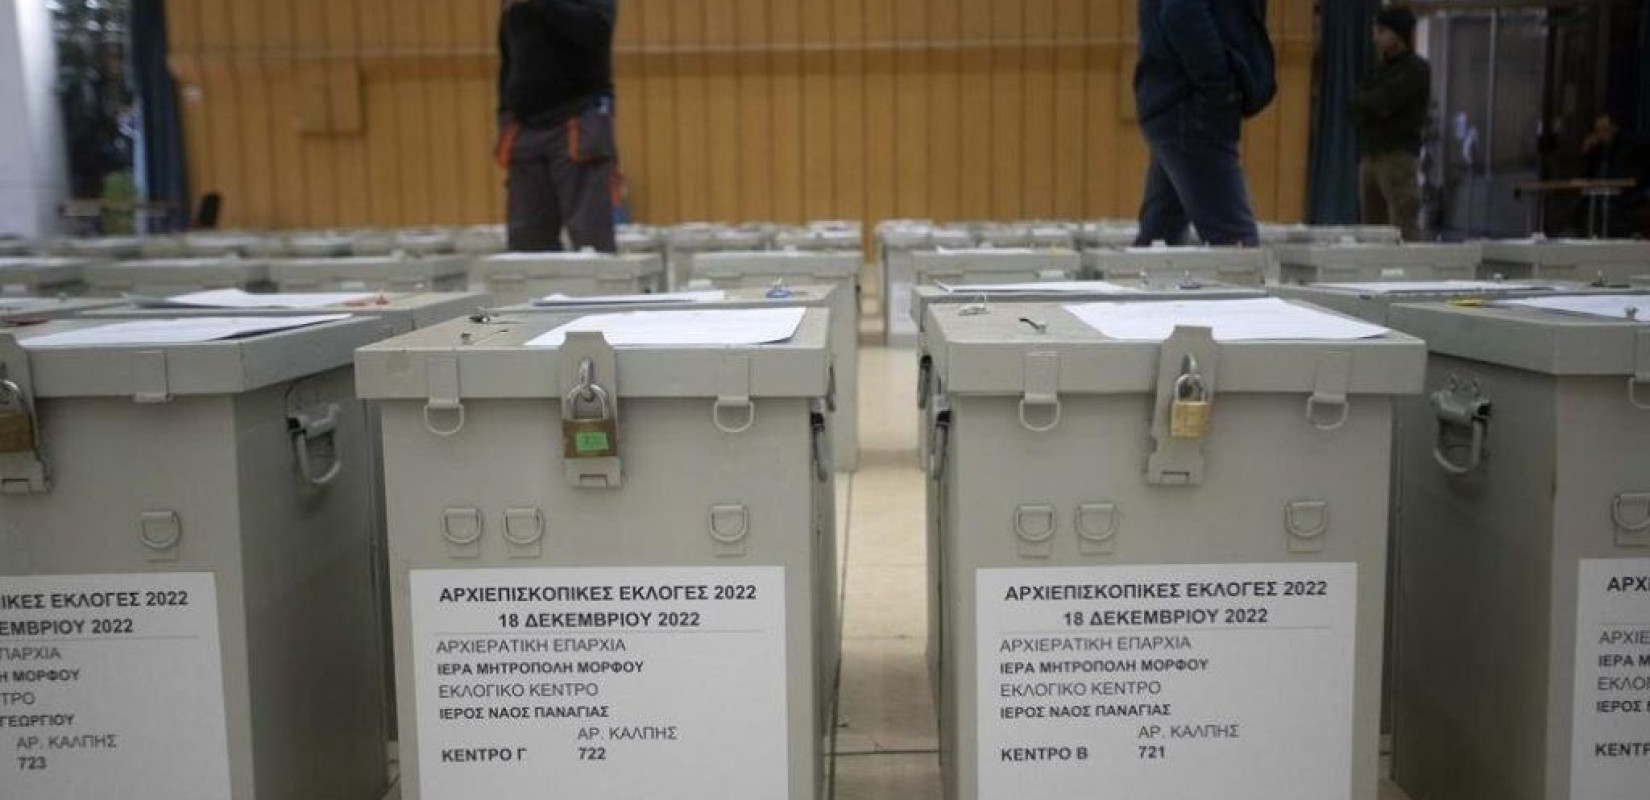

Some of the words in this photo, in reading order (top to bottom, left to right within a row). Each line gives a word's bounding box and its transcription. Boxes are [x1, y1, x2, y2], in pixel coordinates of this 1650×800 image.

[440, 586, 612, 602] ΑΡΧΙΕΠΙΣΚΟΠΙΚΕΣ
[620, 585, 708, 600] ΕΚΛΟΓΕΣ
[714, 585, 756, 600] 2022
[1006, 583, 1180, 600] ΑΡΧΙΕΠΙΣΚΟΠΙΚΕΣ
[1187, 581, 1278, 597] ΕΚΛΟΓΕΣ
[1284, 581, 1327, 596] 2022
[50, 592, 140, 608] ΕΚΛΟΓΕΣ
[146, 591, 187, 606] 2022
[499, 614, 519, 627] 18
[525, 612, 651, 627] ΔΕΚΕΜΒΡΙΟΥ
[659, 612, 699, 627] 2022
[1065, 612, 1083, 626] 18
[1090, 609, 1218, 625] ΔΕΚΕΜΒΡΙΟΥ
[1225, 608, 1267, 623] 2022
[92, 619, 133, 634] 2022
[436, 639, 548, 653] ΑΡΧΙΕΡΑΤΙΚΗ
[553, 638, 626, 653] ΕΠΑΡΧΙΑ
[1000, 638, 1112, 652] ΑΡΧΙΕΡΑΤΙΚΗ
[1118, 636, 1191, 651] ΕΠΑΡΧΙΑ
[438, 664, 472, 675] ΙΕΡΑ
[477, 662, 572, 674] ΜΗΤΡΟΠΟΛΗ
[577, 661, 643, 673] ΜΟΡΦΟΥ
[1000, 662, 1035, 674] ΙΕΡΑ
[1040, 660, 1136, 673] ΜΗΤΡΟΠΟΛΗ
[1141, 659, 1208, 672] ΜΟΡΦΟΥ
[1599, 654, 1634, 667] ΙΕΡΑ
[13, 669, 79, 682] ΜΟΡΦΟΥ
[438, 683, 524, 698] ΕΚΛΟΓΙΚΟ
[530, 683, 598, 696] ΚΕΝΤΡΟ
[1001, 683, 1086, 697] ΕΚΛΟΓΙΚΟ
[1091, 681, 1161, 695] ΚΕΝΤΡΟ
[440, 707, 483, 720] ΙΕΡΟΣ
[488, 707, 530, 719] ΝΑΟΣ
[535, 706, 609, 717] ΠΑΝΑΓΙΑΣ
[1001, 706, 1045, 719] ΙΕΡΟΣ
[1049, 706, 1091, 717] ΝΑΟΣ
[1096, 704, 1170, 716] ΠΑΝΑΓΙΑΣ
[1597, 701, 1642, 712] ΙΕΡΟΣ
[609, 726, 677, 740] ΚΑΛΠΗΣ
[1171, 724, 1239, 738] ΚΑΛΠΗΣ
[48, 734, 116, 749] ΚΑΛΠΗΣ
[442, 748, 512, 762] ΚΕΝΤΡΟ
[517, 748, 527, 759] Γ
[579, 747, 606, 760] 722
[1002, 747, 1071, 761] ΚΕΝΤΡΟ
[1076, 746, 1088, 759] Β
[1139, 746, 1164, 759] 721
[18, 756, 47, 770] 723
